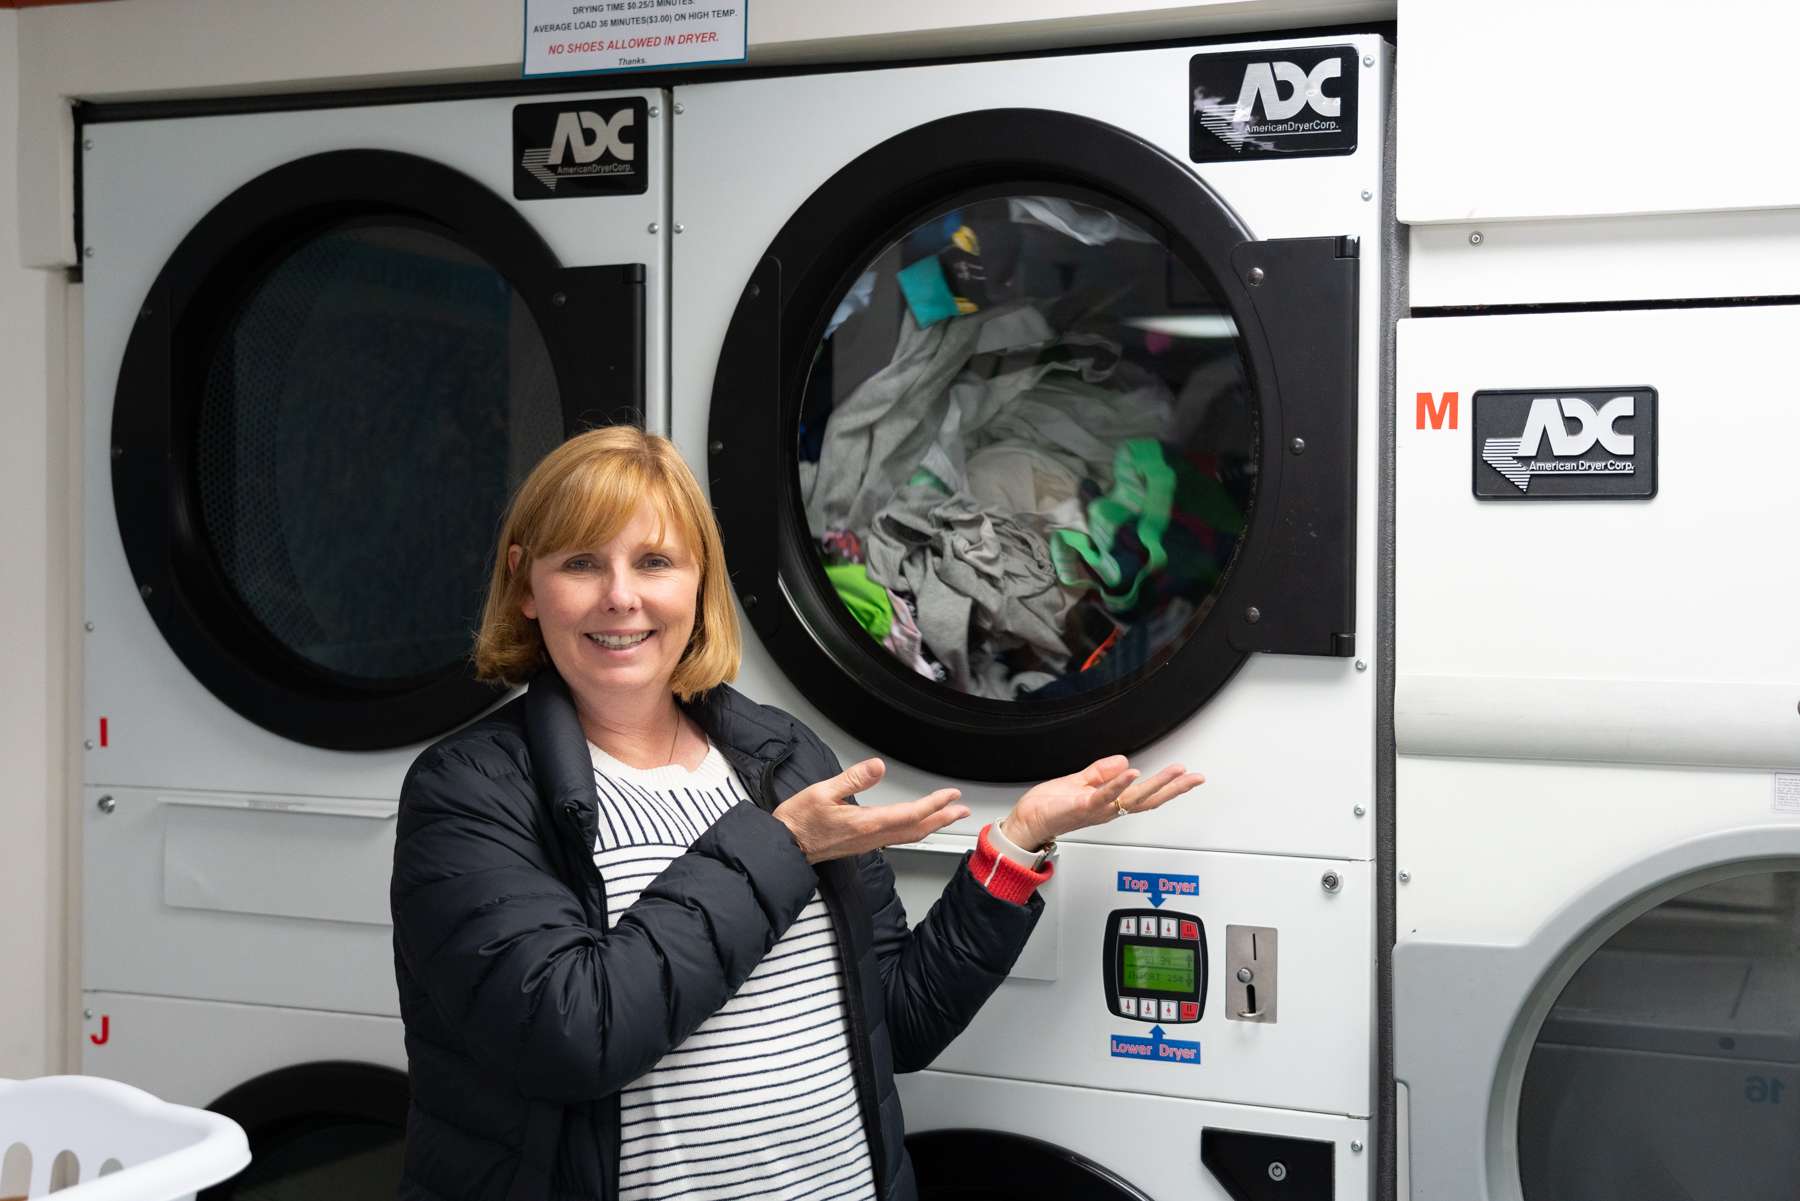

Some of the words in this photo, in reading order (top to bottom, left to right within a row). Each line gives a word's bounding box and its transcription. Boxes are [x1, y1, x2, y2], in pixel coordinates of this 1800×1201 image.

[572, 5, 604, 15] DRYING
[606, 3, 625, 12] TIME
[627, 1, 655, 10] $0.25/3
[533, 23, 572, 33] AVERAGE
[574, 21, 597, 30] LOAD
[610, 15, 672, 26] MINUTES($3.00)
[674, 13, 686, 21] ON
[688, 11, 709, 20] HIGH
[711, 9, 738, 18] TEMP.
[548, 44, 565, 55] NO
[567, 41, 604, 53] SHOES
[607, 36, 662, 51] ALLOWED
[664, 35, 675, 46] IN
[677, 32, 719, 45] DRYER.
[618, 57, 647, 66] Thanks.
[1233, 57, 1341, 121] ADC
[547, 108, 634, 164] ADC
[1416, 392, 1459, 430] M
[1517, 396, 1635, 457] ADC
[1529, 461, 1577, 471] American
[1578, 461, 1607, 471] Dryer
[1607, 460, 1635, 470] Corp.
[1123, 876, 1149, 892] Top
[1159, 878, 1197, 895] Dryer
[1128, 970, 1161, 981] INSERT
[90, 1014, 110, 1046] J
[1112, 1039, 1153, 1055] Lower
[1159, 1043, 1197, 1060] Dryer
